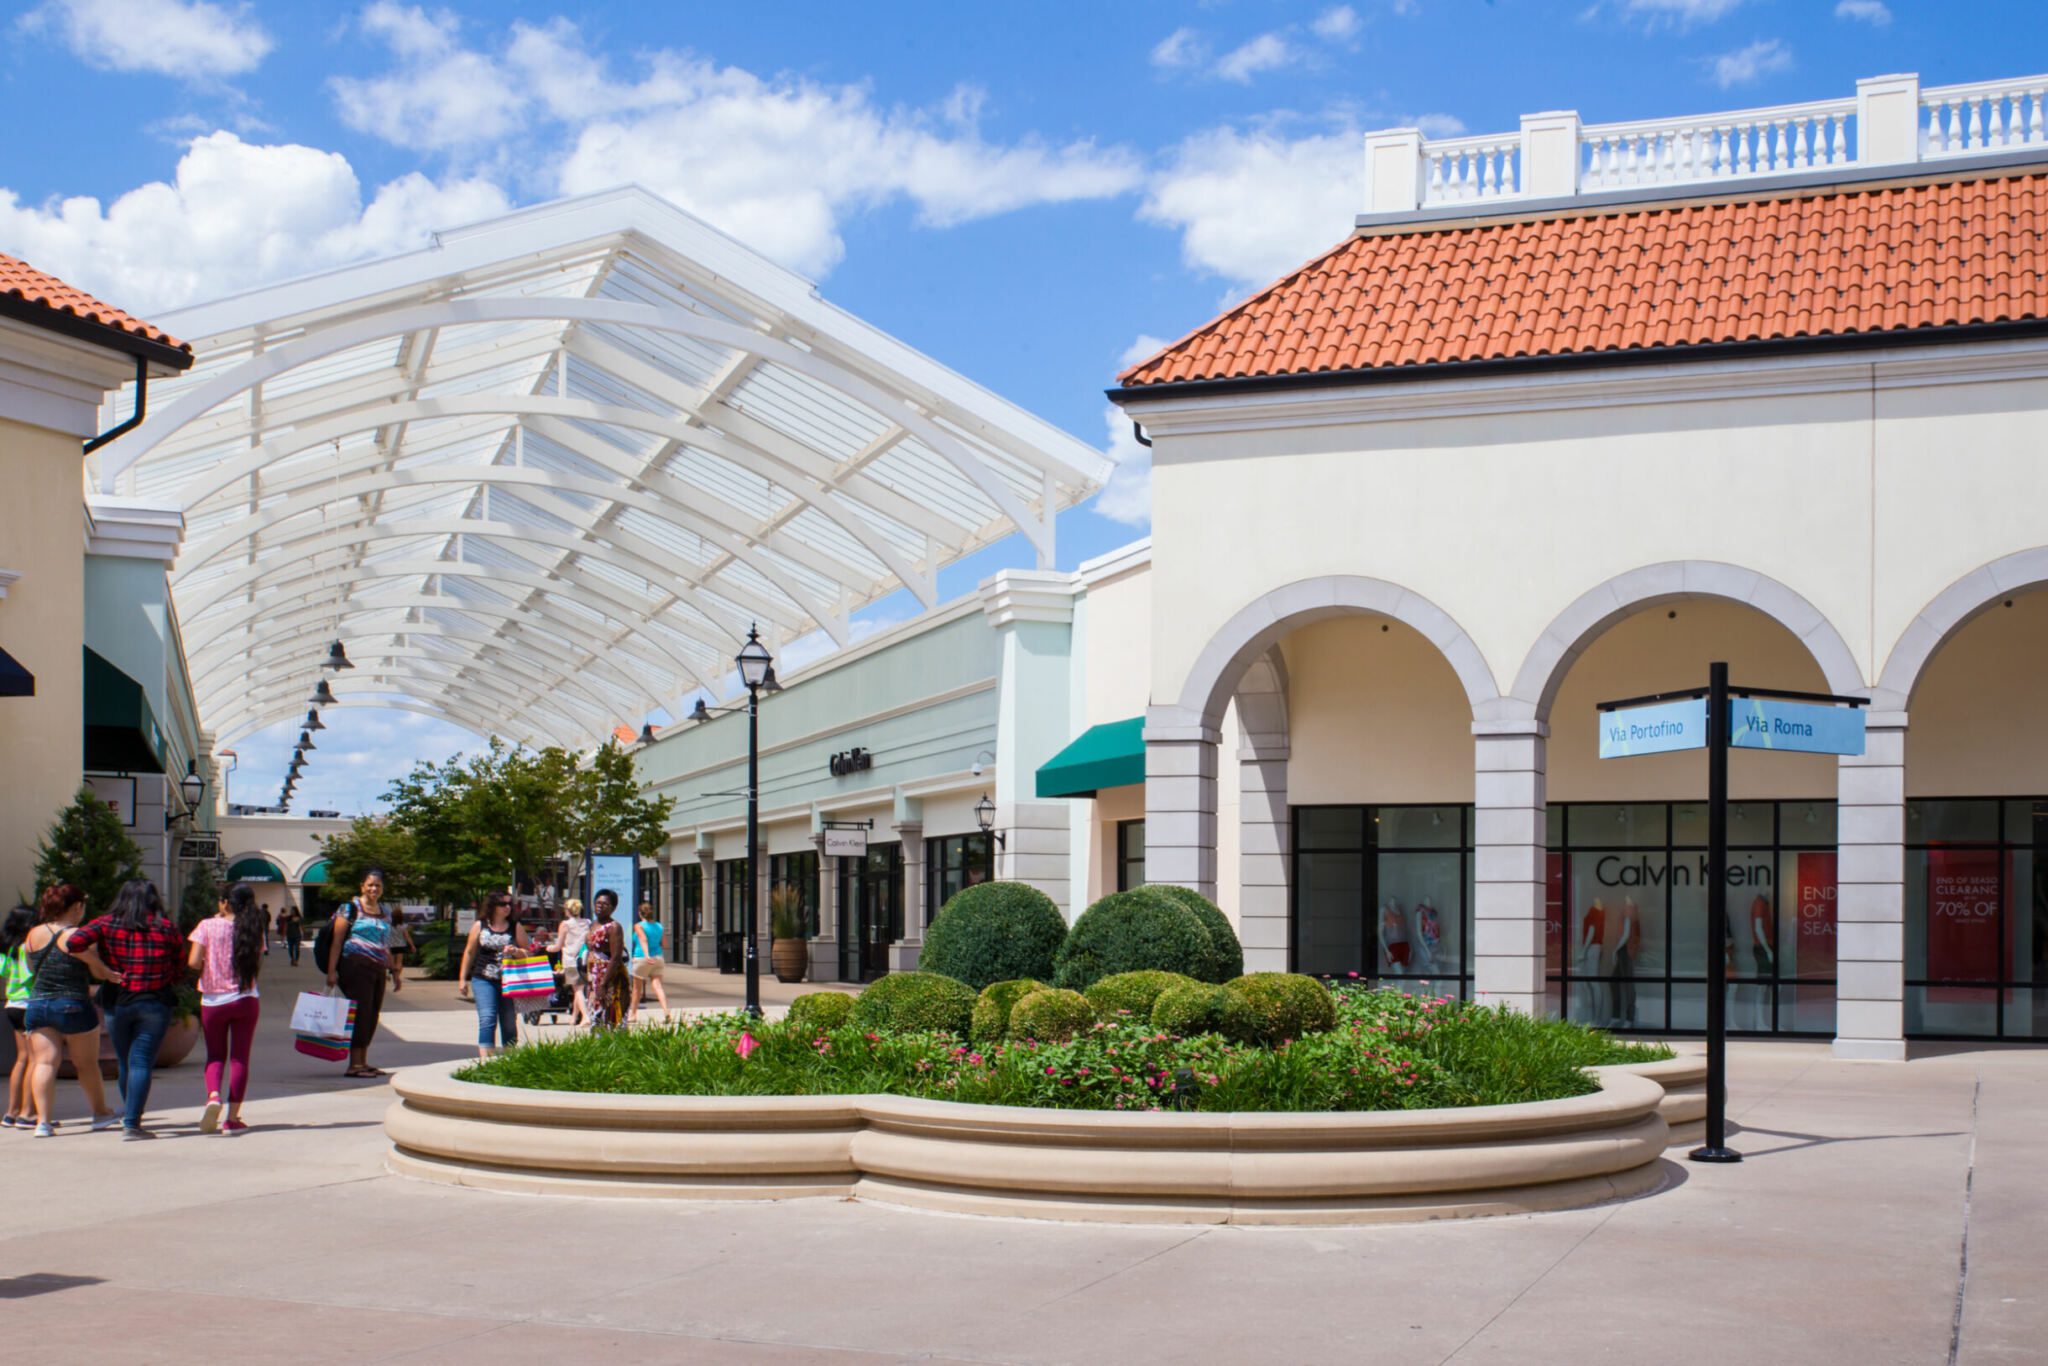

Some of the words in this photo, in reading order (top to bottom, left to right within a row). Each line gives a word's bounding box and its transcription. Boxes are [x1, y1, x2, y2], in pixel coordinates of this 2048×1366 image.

[1609, 727, 1627, 742] Via
[1630, 720, 1684, 741] Portofino
[1746, 715, 1769, 733] Via
[1774, 717, 1813, 737] Roma
[1596, 855, 1690, 887] Calvn
[1699, 855, 1772, 887] Kein
[1956, 876, 1968, 884] OF
[1803, 886, 1837, 900] END
[1936, 885, 1998, 895] CLEARANC
[1803, 903, 1825, 918] OF
[1935, 901, 1971, 916] 70%
